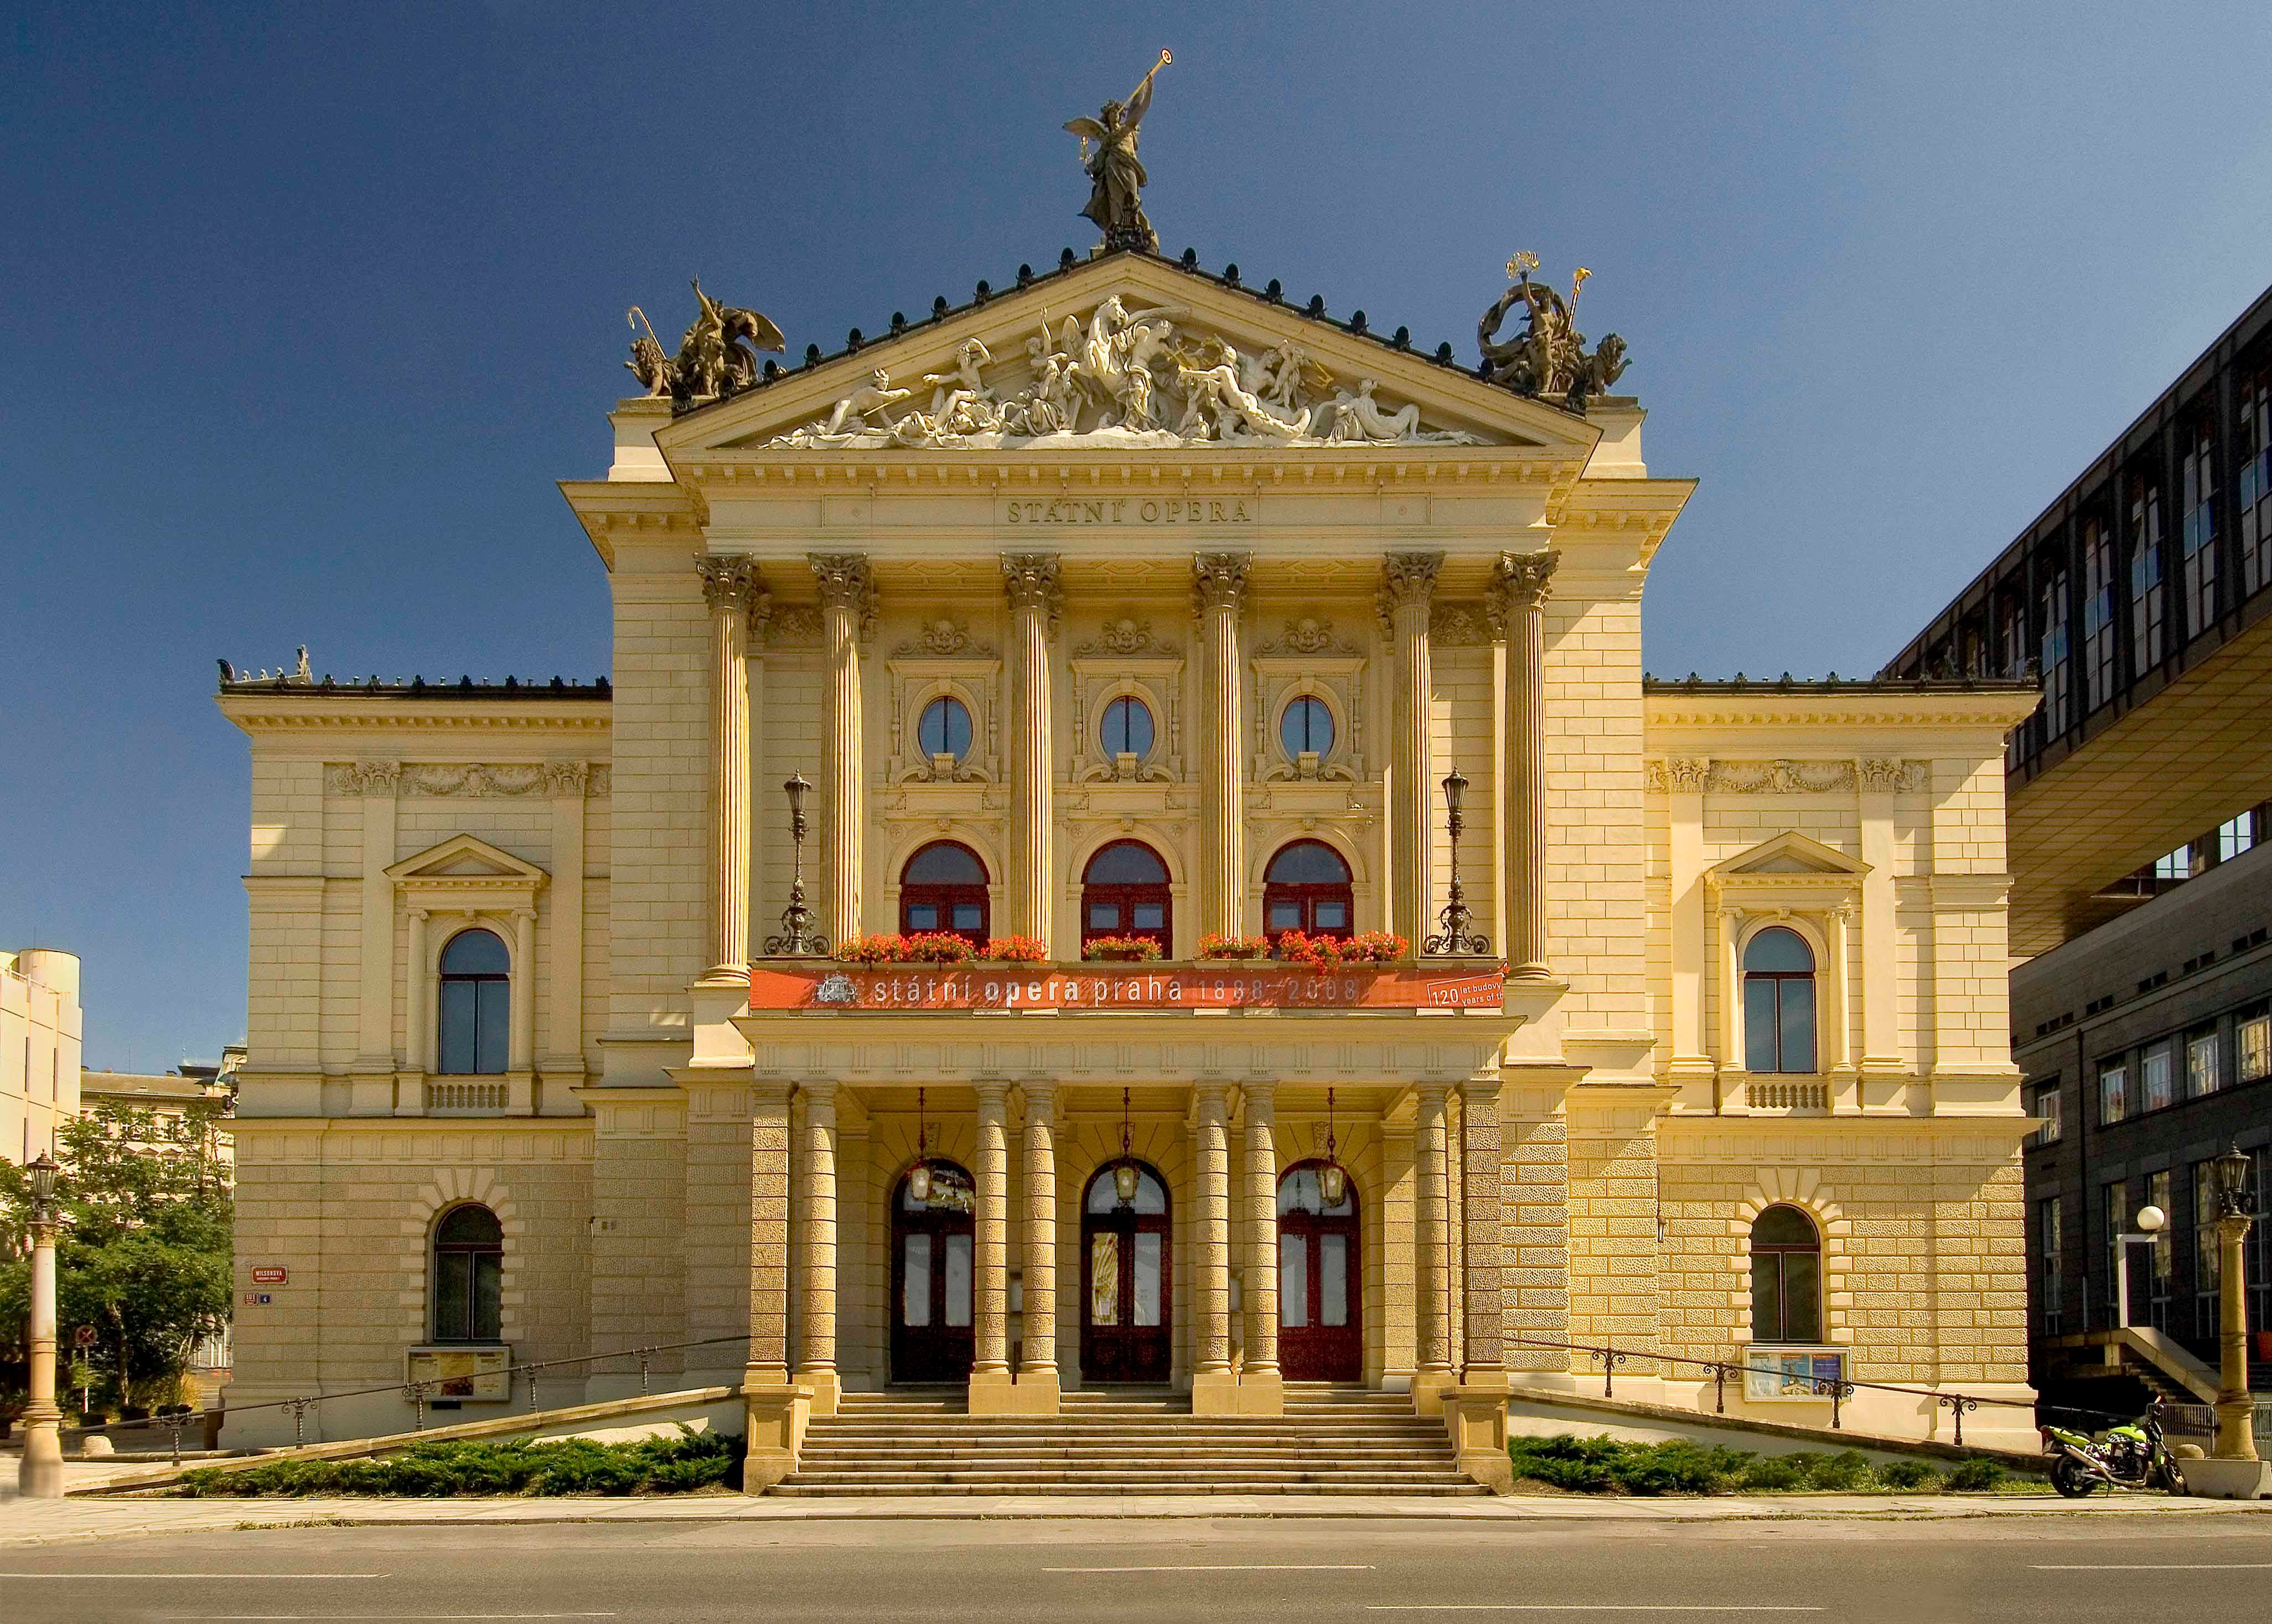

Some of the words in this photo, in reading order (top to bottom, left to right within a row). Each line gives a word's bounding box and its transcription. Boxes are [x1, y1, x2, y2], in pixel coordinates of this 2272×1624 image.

[1008, 498, 1125, 522] STÁTNÍ
[1141, 500, 1250, 522] OPERA
[874, 974, 971, 1001] státní
[985, 981, 1079, 1008] opera
[1094, 974, 1182, 1007] praha
[1432, 988, 1459, 1006] 120
[1460, 986, 1471, 994] let
[1473, 982, 1501, 992] budovy
[1462, 996, 1484, 1006] years
[1487, 992, 1494, 1001] of
